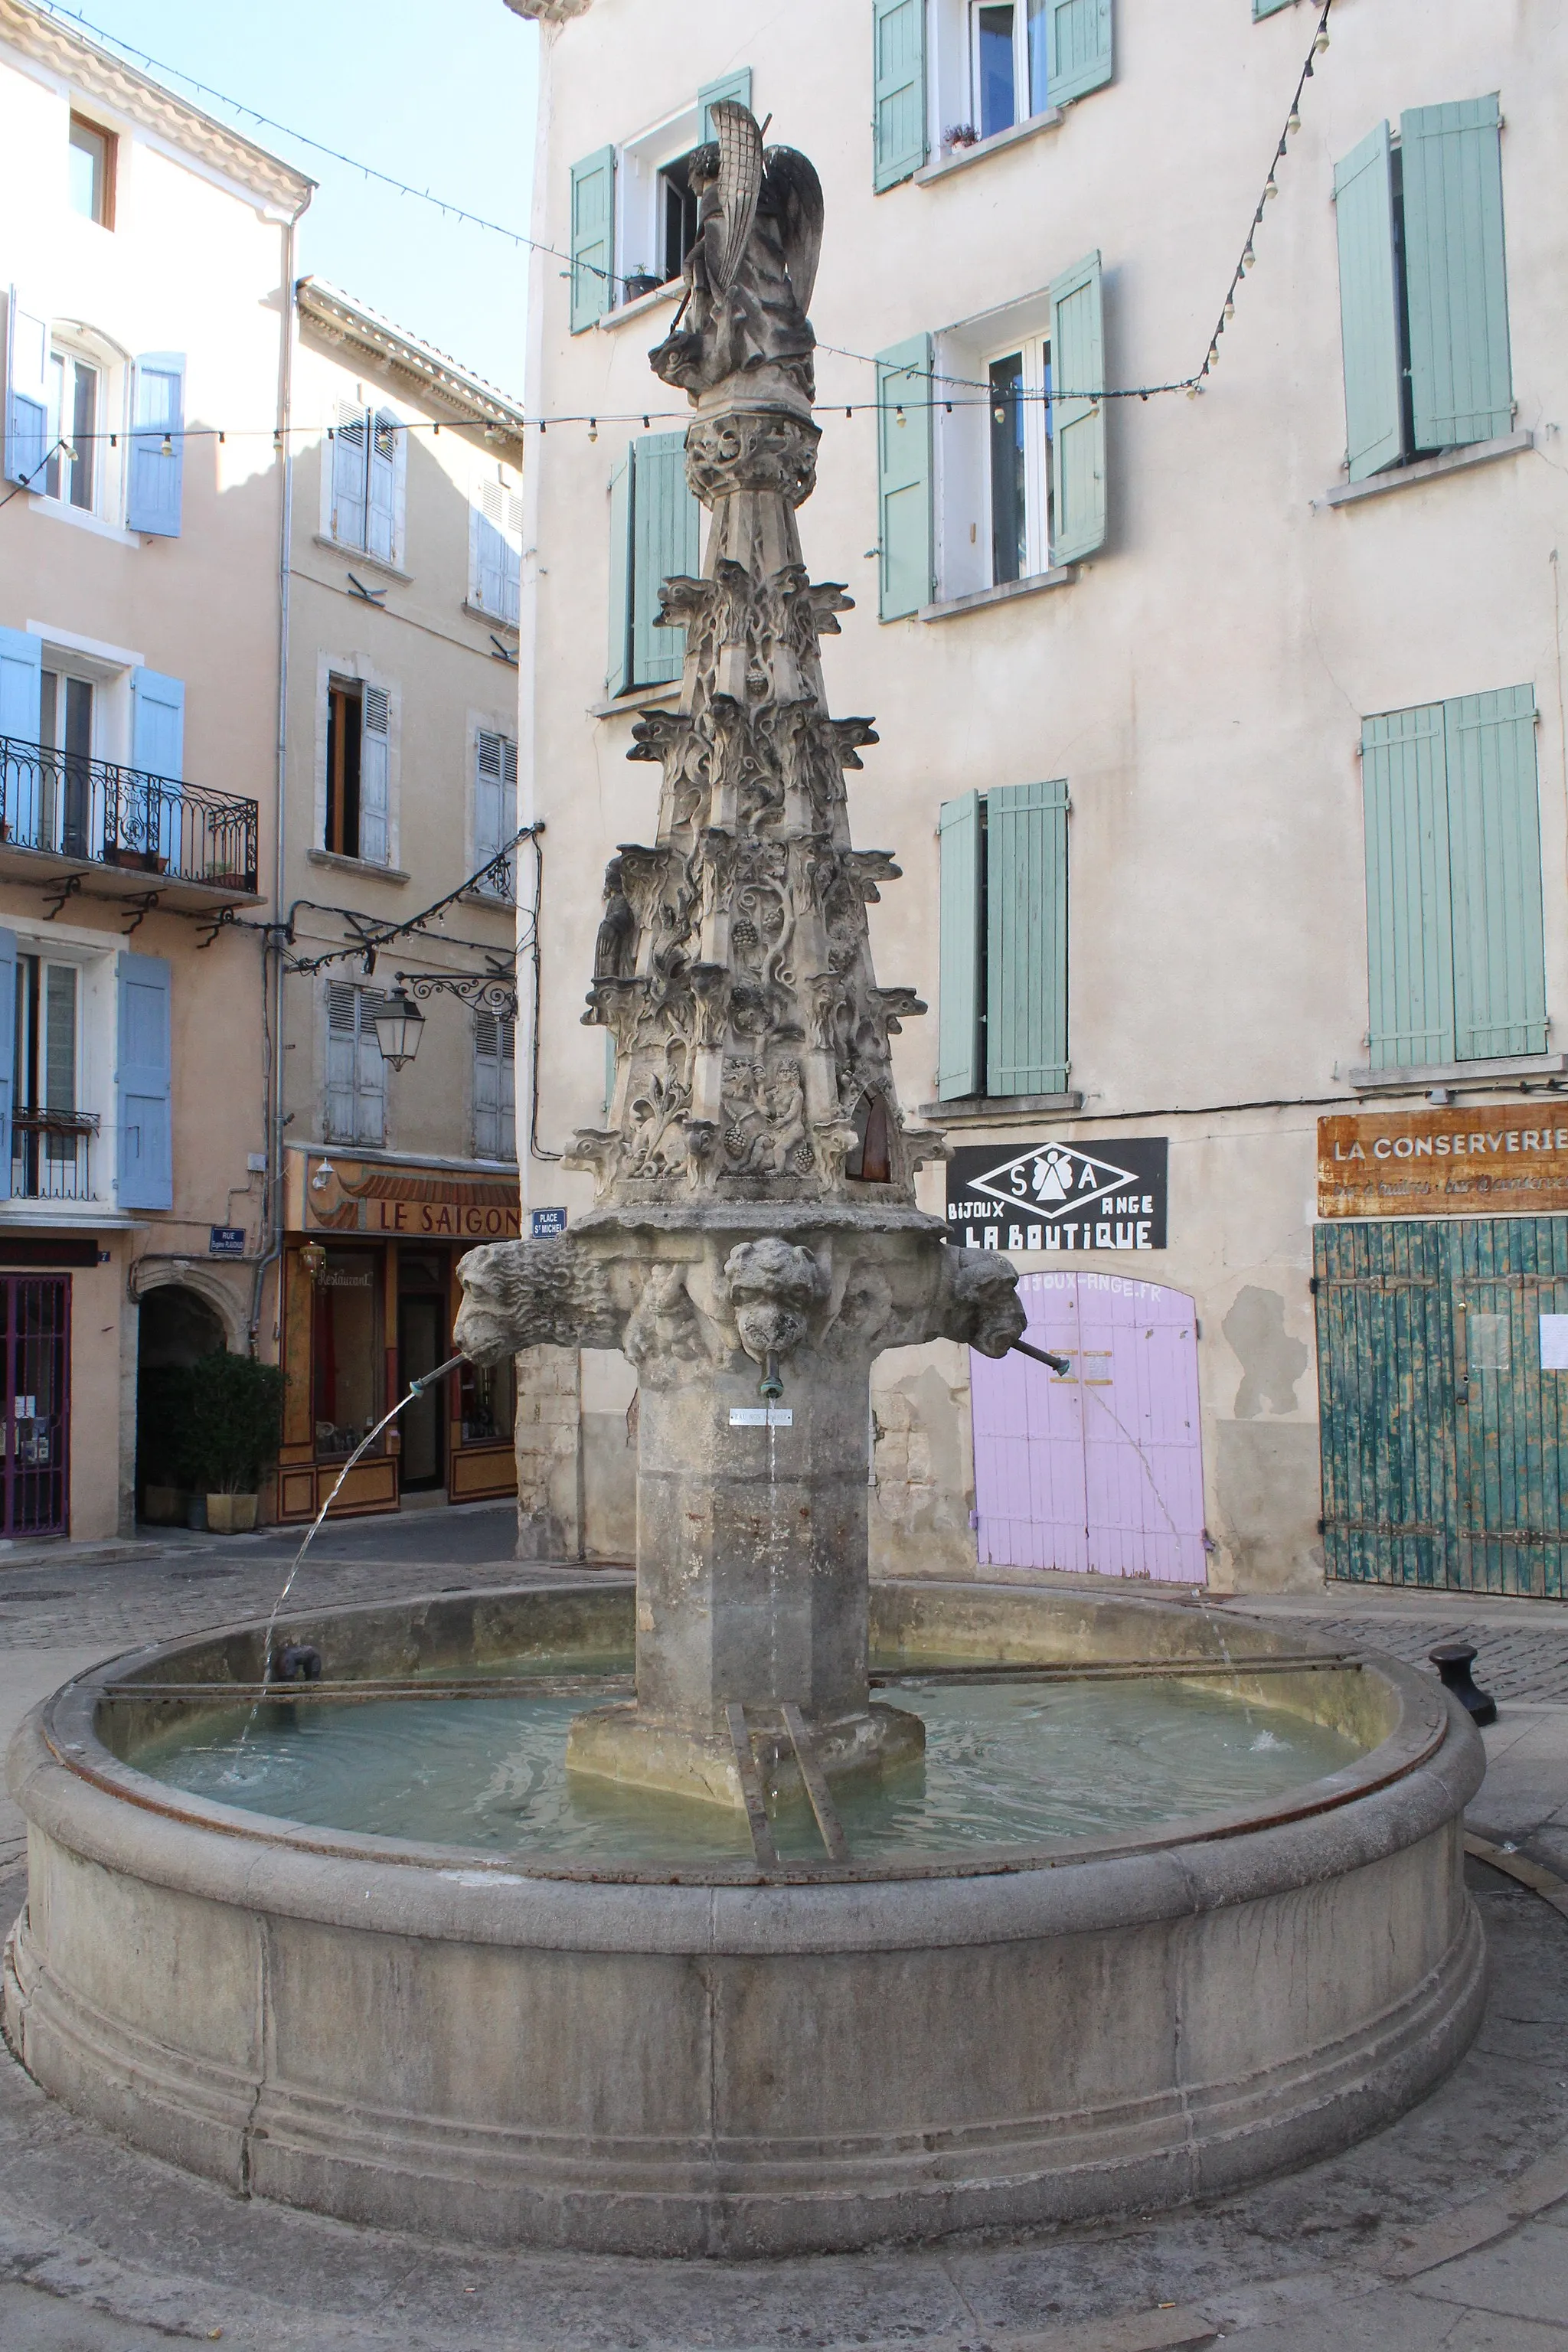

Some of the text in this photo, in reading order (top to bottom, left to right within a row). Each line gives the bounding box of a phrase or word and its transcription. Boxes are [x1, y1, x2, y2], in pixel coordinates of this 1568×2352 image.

[1334, 1128, 1568, 1161] LA CONSERVERIE
[1010, 1163, 1098, 1196] S A
[1102, 1195, 1154, 1215] ANGE
[381, 1202, 521, 1234] LE SAIGON
[540, 1214, 557, 1223] PLACE
[541, 1224, 562, 1233] MICHEL
[965, 1226, 998, 1250] LA
[102, 1253, 107, 1261] 7
[318, 1269, 374, 1286] Restaurant
